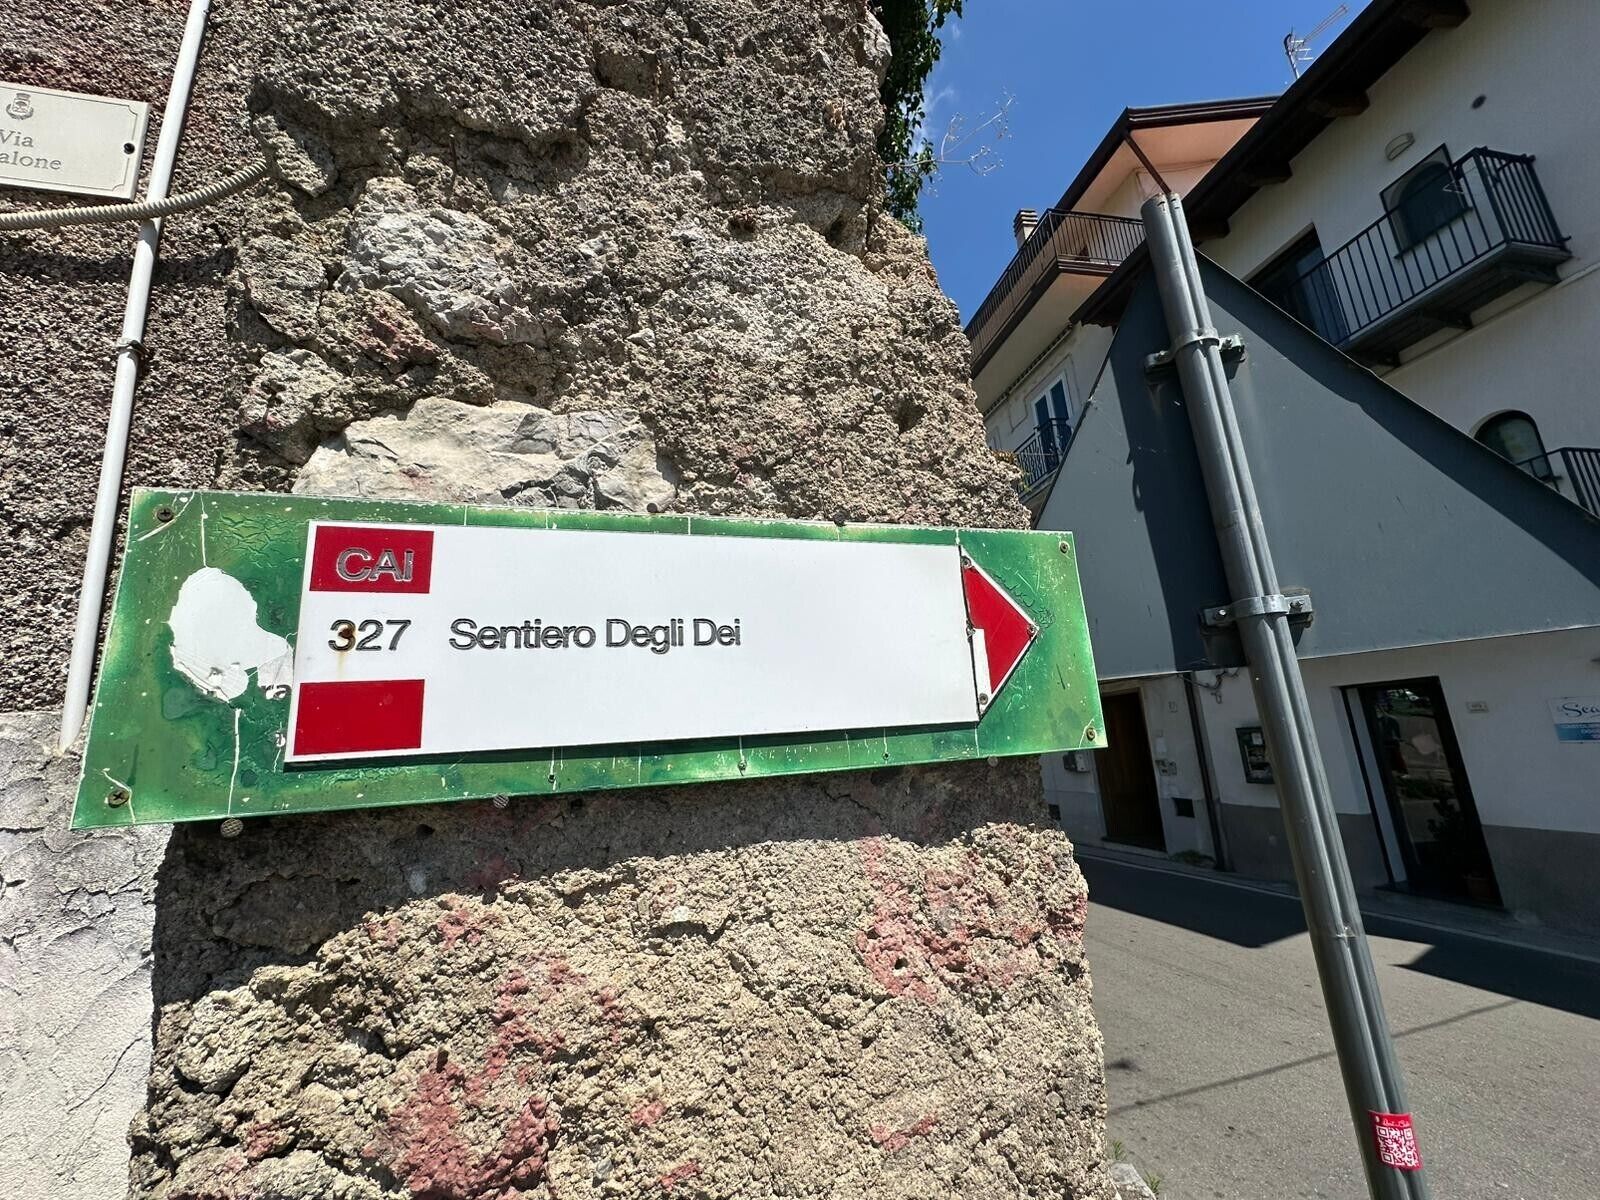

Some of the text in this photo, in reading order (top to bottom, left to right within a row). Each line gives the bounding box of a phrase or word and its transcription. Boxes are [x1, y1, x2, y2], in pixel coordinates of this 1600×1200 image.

[0, 129, 34, 148] Via
[336, 547, 415, 582] CAI
[328, 619, 412, 652] 327
[449, 618, 741, 655] Sentiero Degli Dei
